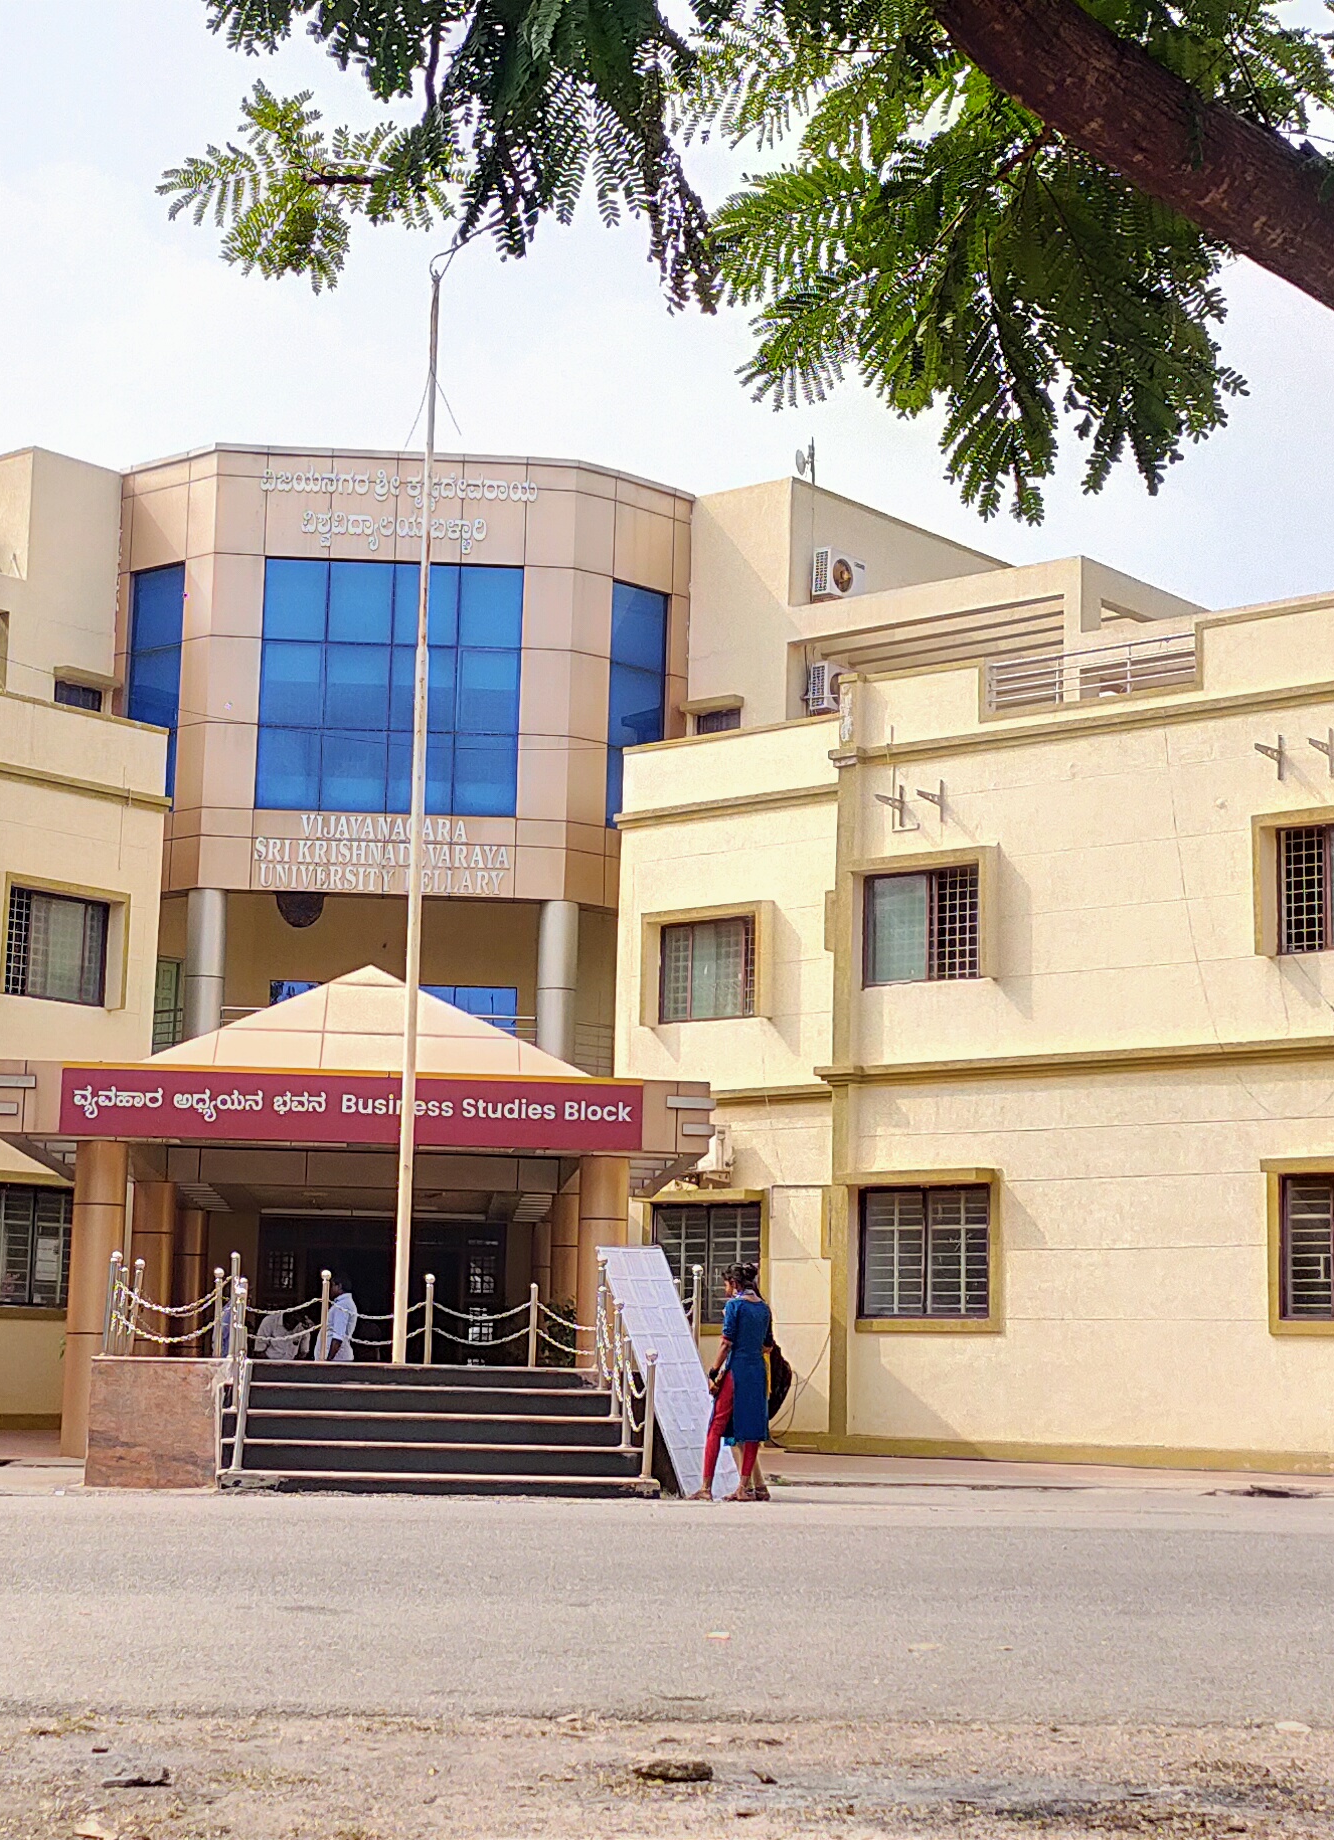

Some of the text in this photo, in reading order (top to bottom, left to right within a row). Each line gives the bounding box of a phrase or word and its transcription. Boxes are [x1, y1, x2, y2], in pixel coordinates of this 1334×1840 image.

[260, 466, 370, 495] ವಿಜಯನಗರ
[373, 469, 400, 502] ಶ್ರೀ
[254, 837, 511, 869] SRI KRISHNADVARAYA
[259, 863, 395, 892] UNIVERSITY
[72, 1085, 327, 1122] ವ್ಯವಹಾರ ಅಧ್ಯಯನ ಭವನ
[462, 1098, 556, 1120] Studies
[564, 1100, 633, 1122] Block
